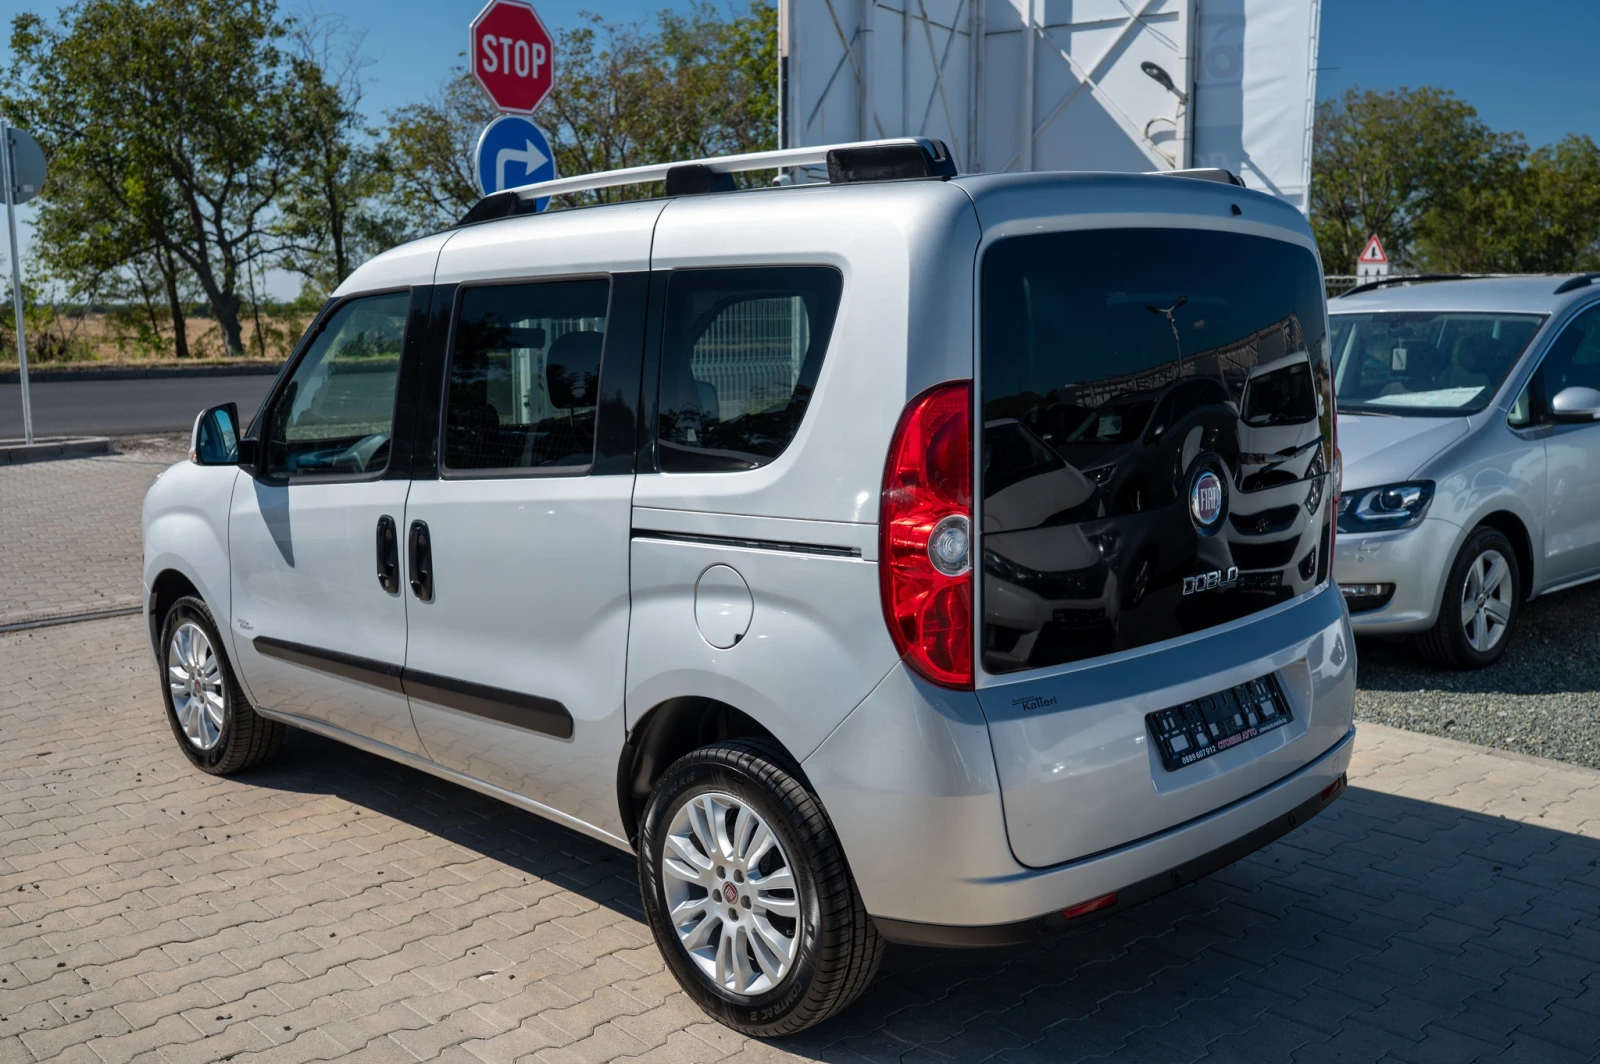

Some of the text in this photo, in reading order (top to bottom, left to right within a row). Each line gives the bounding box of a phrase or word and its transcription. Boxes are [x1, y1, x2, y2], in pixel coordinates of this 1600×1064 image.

[482, 34, 546, 79] STOP
[1200, 487, 1216, 511] FIAT
[1183, 566, 1239, 595] DOBLO
[1196, 749, 1206, 759] 607
[1206, 745, 1216, 754] 912
[750, 982, 803, 1021] COMTRAC 2
